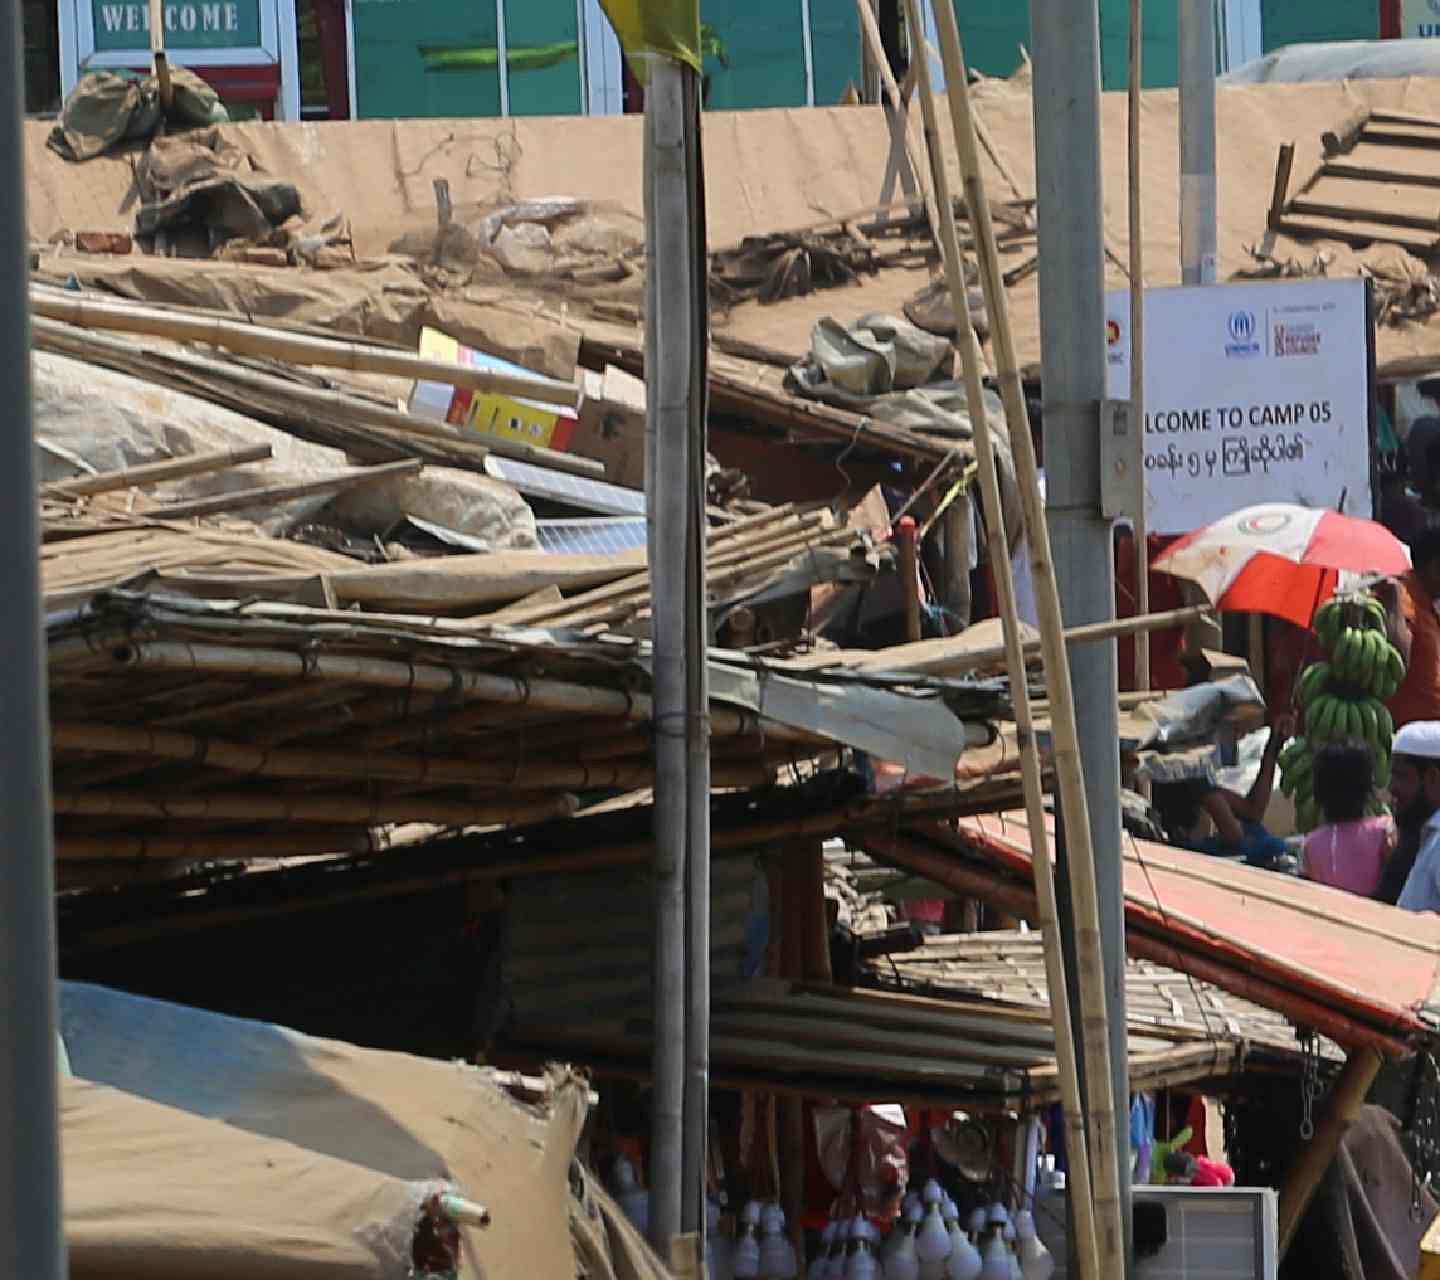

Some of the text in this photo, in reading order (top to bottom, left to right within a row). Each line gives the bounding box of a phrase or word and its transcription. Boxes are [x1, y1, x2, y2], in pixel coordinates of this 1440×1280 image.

[1217, 406, 1243, 429] TO
[1250, 403, 1304, 426] CAMP
[1309, 401, 1332, 423] 05
